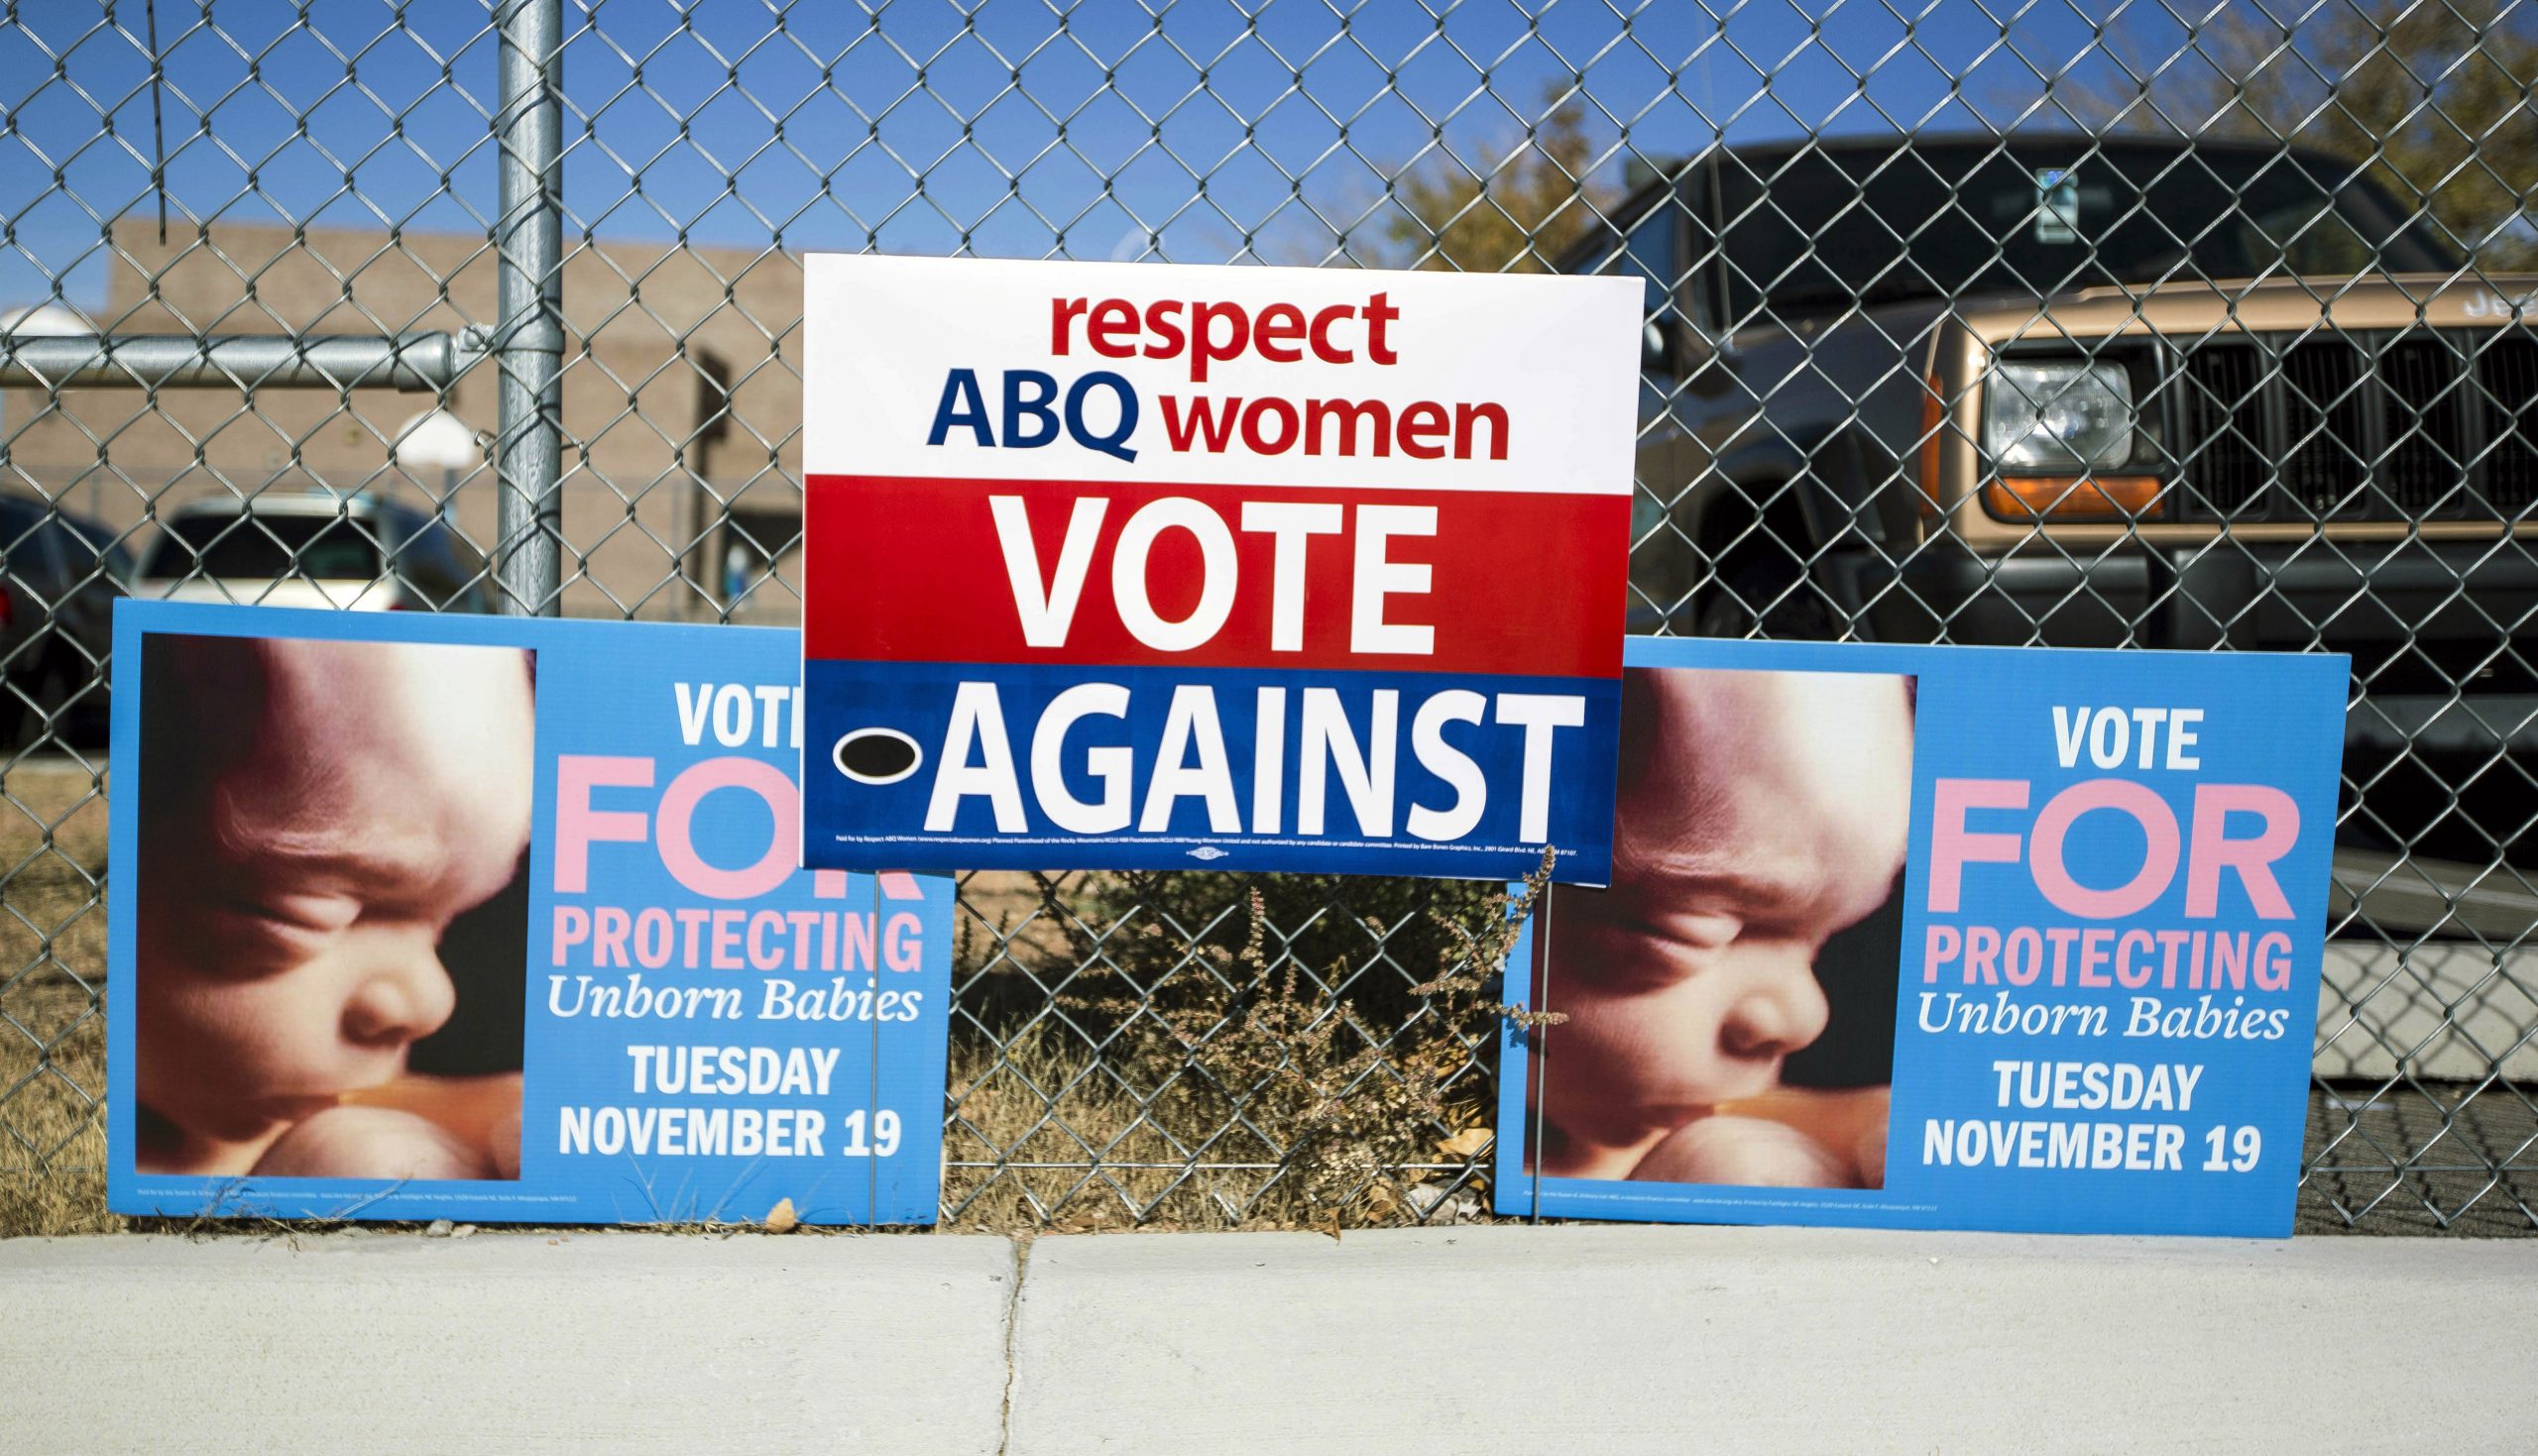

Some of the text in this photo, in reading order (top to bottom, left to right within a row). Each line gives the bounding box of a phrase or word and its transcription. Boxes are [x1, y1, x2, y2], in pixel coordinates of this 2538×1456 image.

[1052, 292, 1400, 383] respect
[927, 368, 1510, 463] ABQ women
[988, 495, 1440, 655] VOTE
[923, 681, 1586, 844] AGAINST
[2052, 705, 2205, 771] VOTE
[553, 755, 924, 901] FO
[1928, 778, 2301, 920] FOR
[551, 906, 922, 972] PROTECTING
[1923, 926, 2292, 991] PROTECTING
[548, 975, 923, 1023] Unborn Babies
[1918, 991, 2289, 1041] Unborn Babies
[627, 1045, 841, 1096] TUESDAY
[1993, 1061, 2204, 1112] TUESDAY
[558, 1106, 901, 1158] NOVEMBER 19
[1921, 1119, 2262, 1174] NOVEMBER 19
